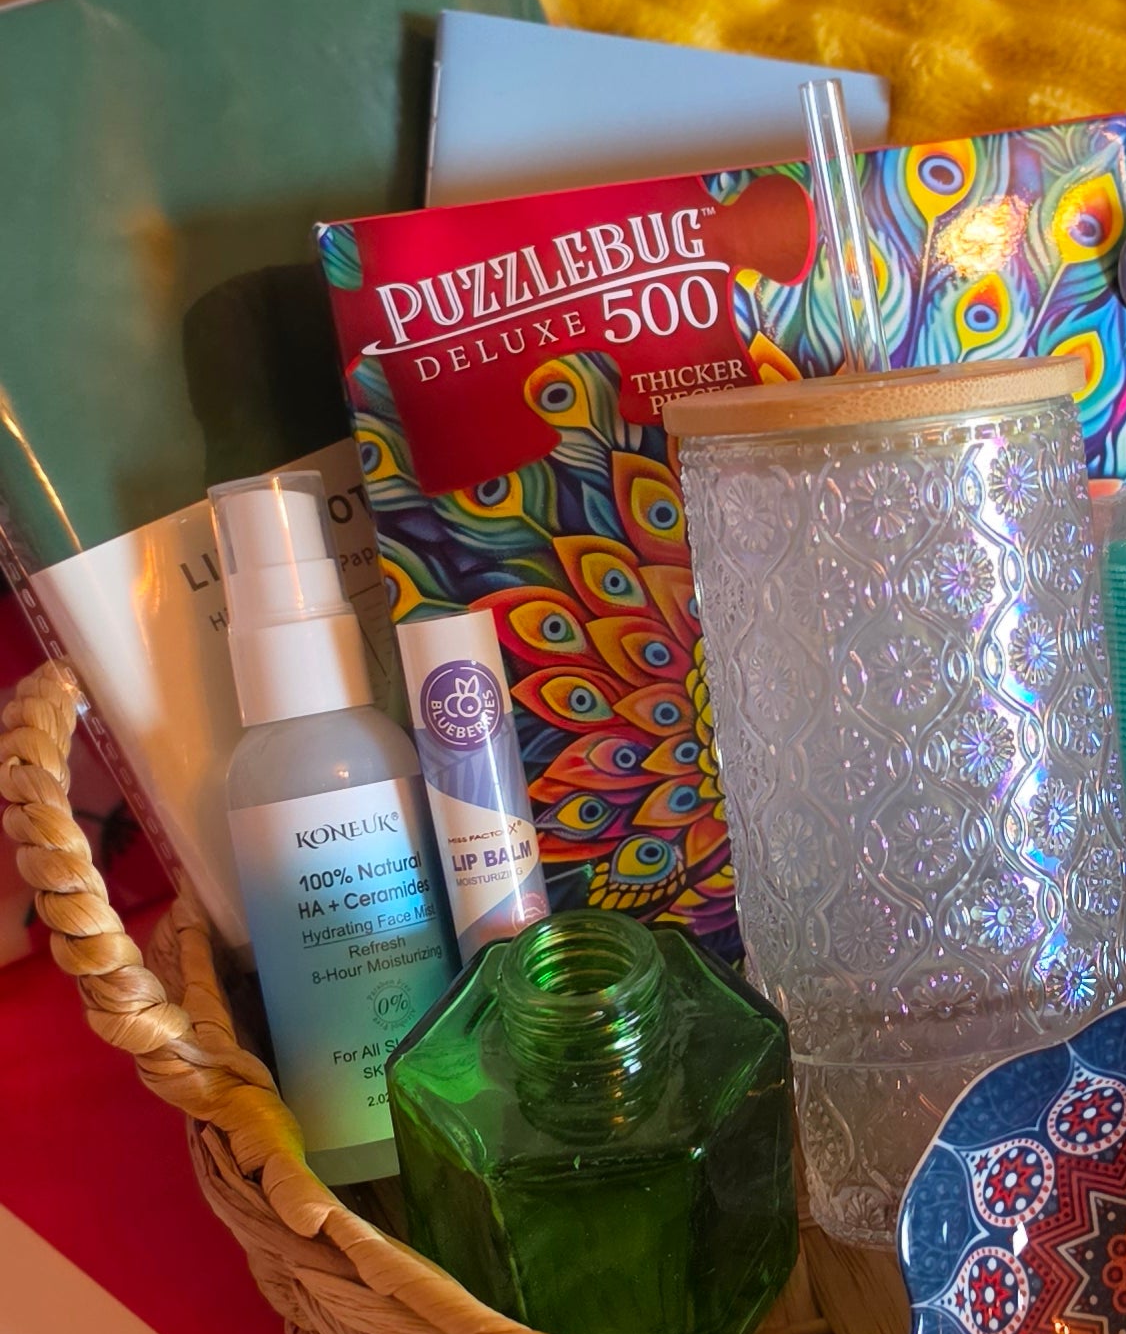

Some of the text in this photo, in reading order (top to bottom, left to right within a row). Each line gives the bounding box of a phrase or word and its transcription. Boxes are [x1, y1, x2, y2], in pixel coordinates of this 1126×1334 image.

[413, 275, 719, 383] DELUXE 500
[630, 359, 748, 394] THICKER
[327, 483, 373, 524] OT
[180, 548, 221, 592] LI
[430, 689, 496, 739] BLUEBERRIES
[299, 850, 422, 892] 100% Natural
[452, 840, 533, 872] LIP BALM
[298, 877, 430, 920] HA + Ceramides
[302, 903, 436, 946] Hydrating Face Mist
[312, 943, 443, 985] 8-Hour Moisturizing
[348, 935, 407, 959] Refresh
[377, 993, 409, 1017] 0%
[332, 1049, 358, 1065] For
[361, 1042, 381, 1060] All
[363, 1064, 386, 1080] SK
